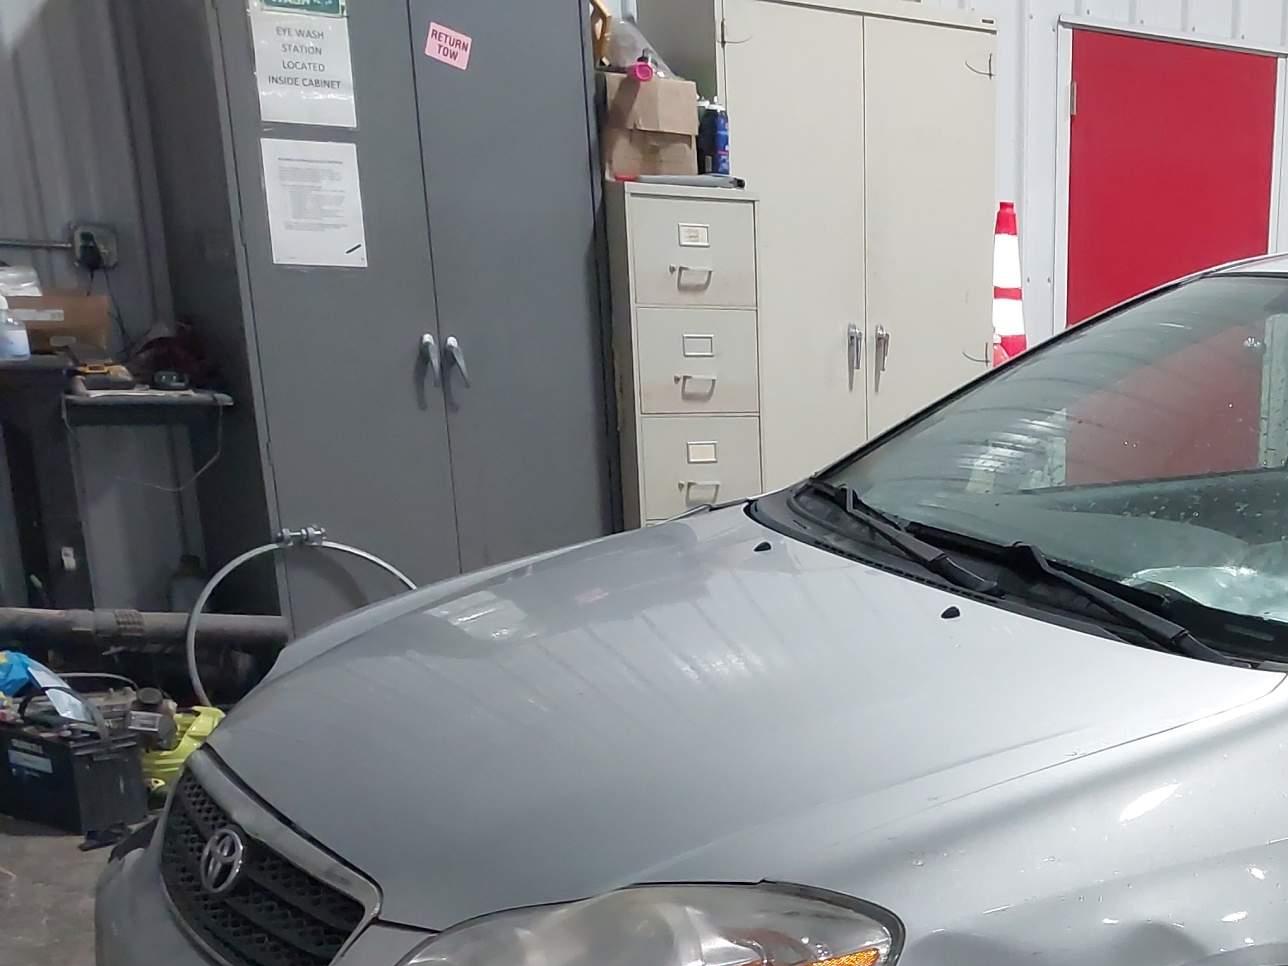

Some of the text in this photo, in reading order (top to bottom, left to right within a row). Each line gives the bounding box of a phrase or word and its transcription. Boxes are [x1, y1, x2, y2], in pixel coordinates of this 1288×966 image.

[275, 26, 324, 39] EYE WASH
[431, 28, 469, 52] RETURN
[281, 43, 322, 55] STATION
[437, 43, 459, 60] TOW
[282, 60, 325, 72] LOCATED
[268, 75, 341, 89] INSIDE CABINET
